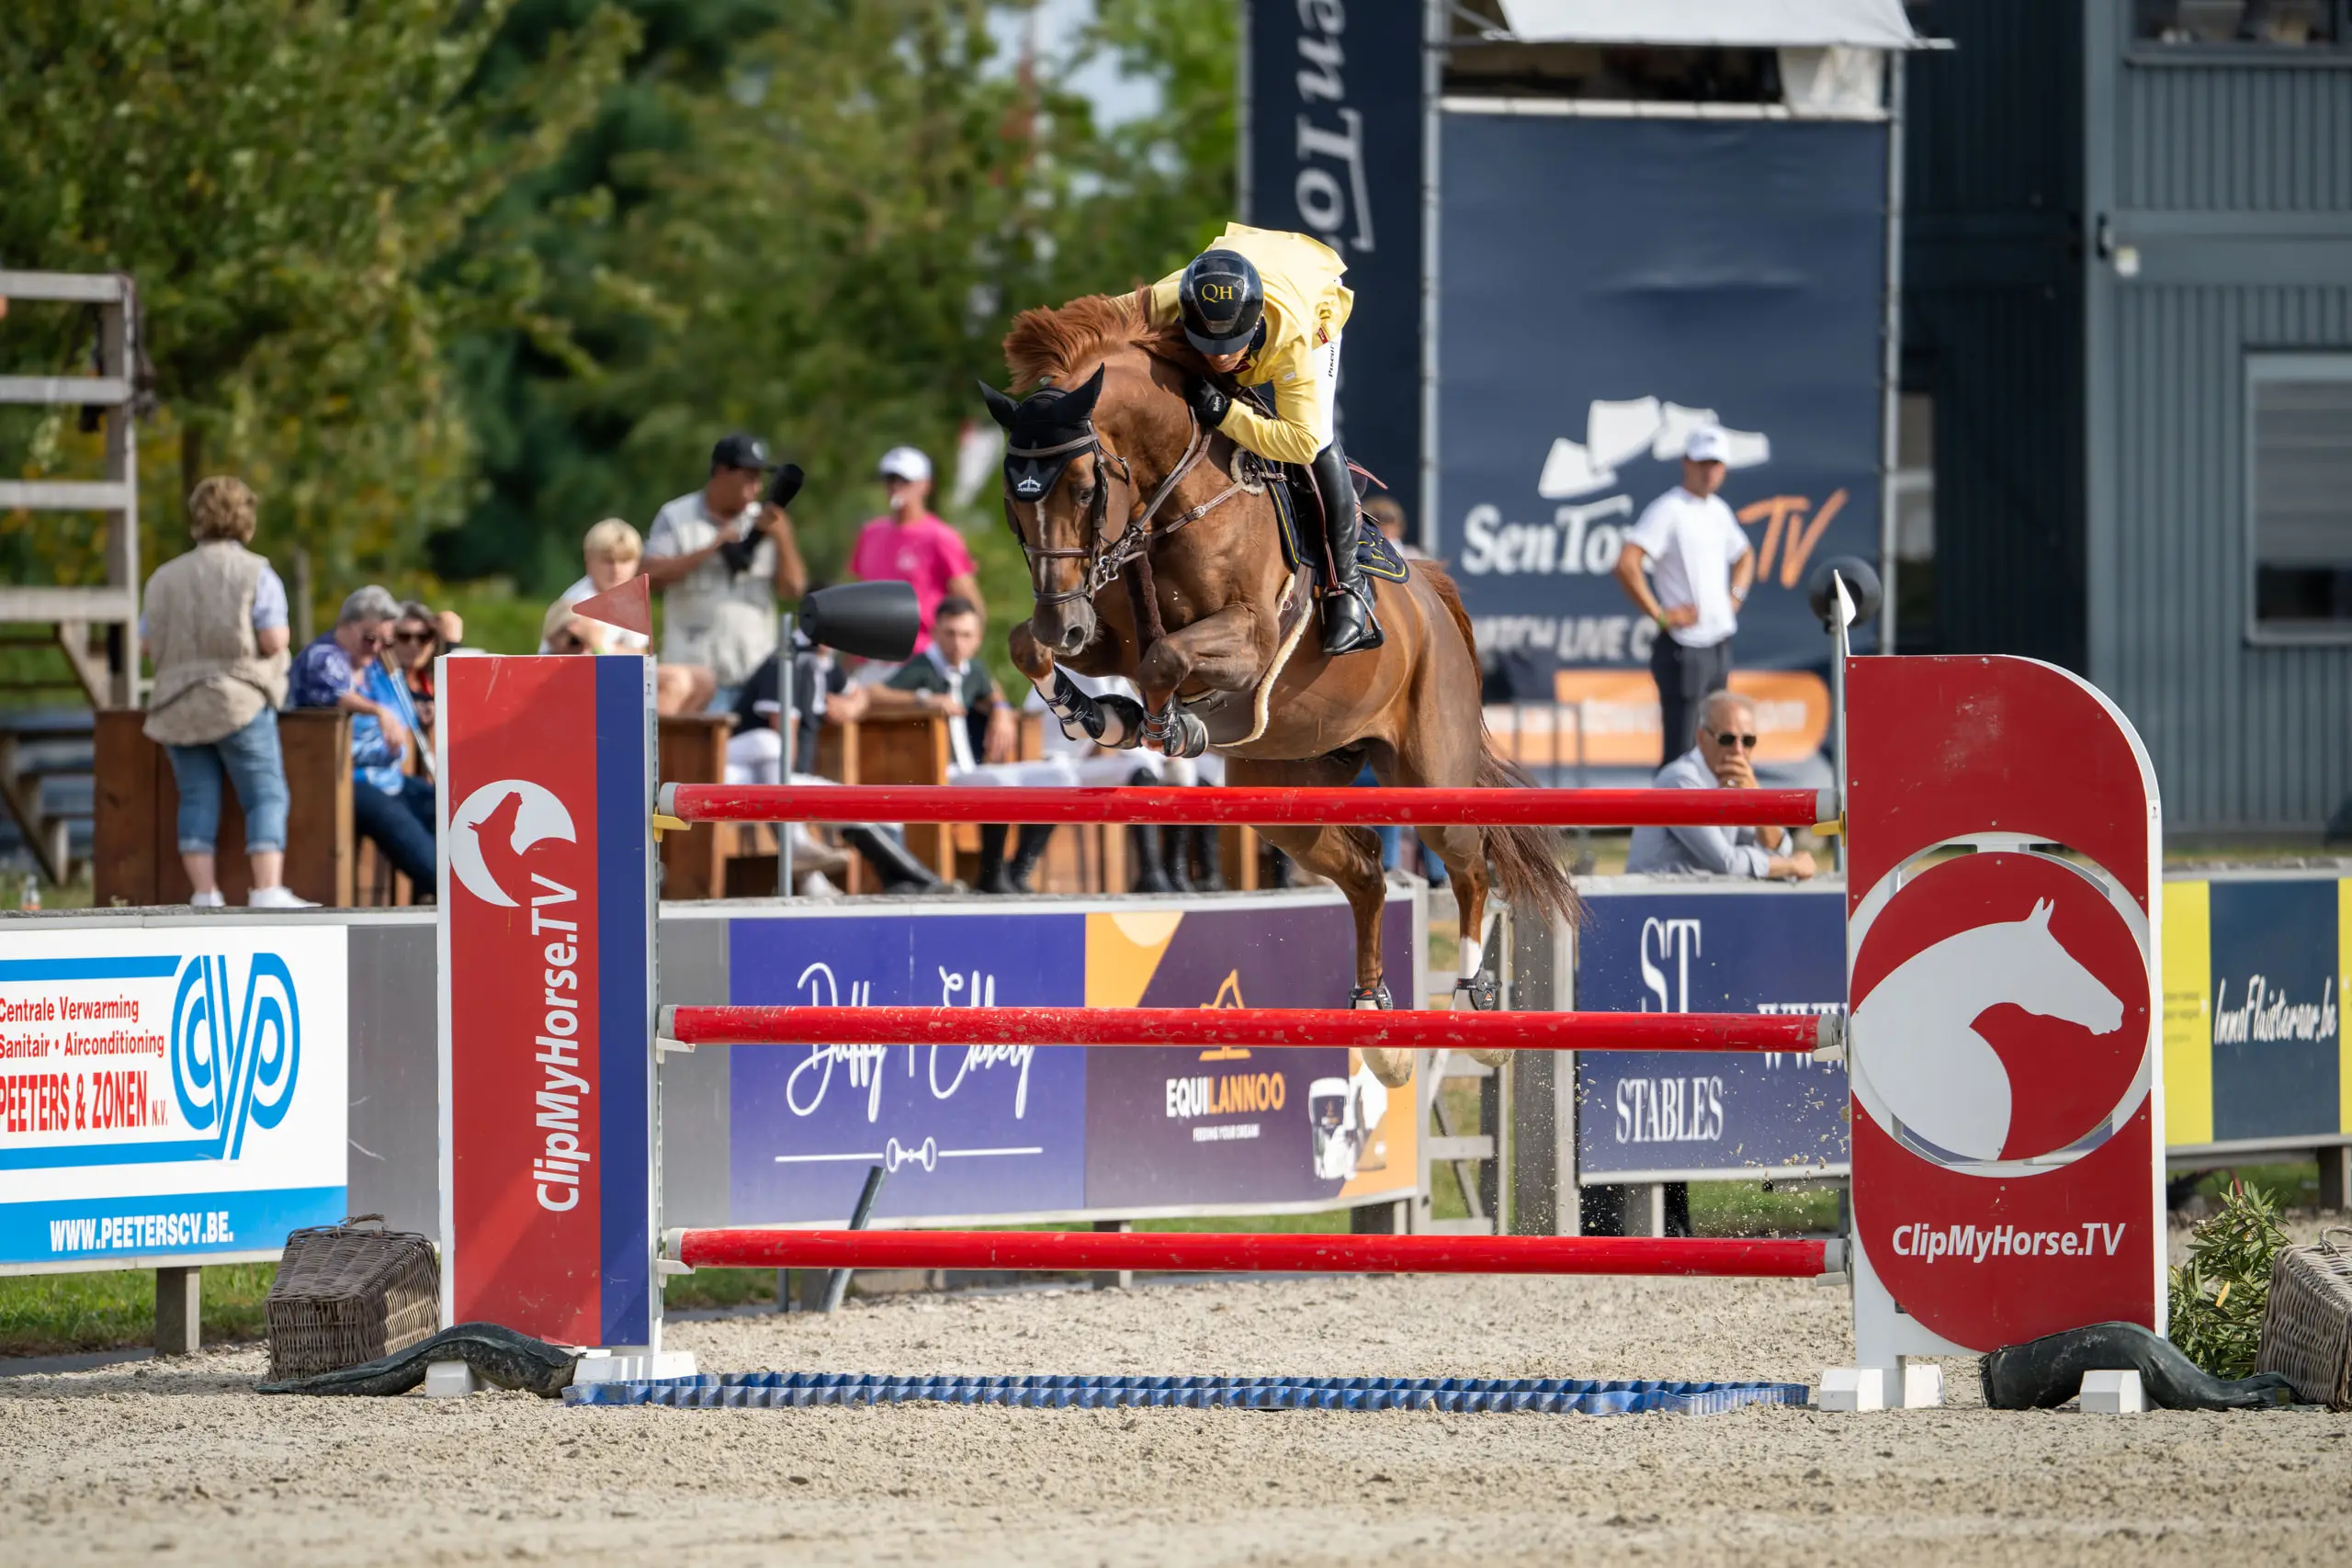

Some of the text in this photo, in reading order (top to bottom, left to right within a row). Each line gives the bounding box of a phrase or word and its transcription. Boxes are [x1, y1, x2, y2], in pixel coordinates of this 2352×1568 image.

[1201, 283, 1234, 303] QH
[1736, 488, 1849, 589] TV
[1641, 917, 1702, 1013] ST
[0, 994, 139, 1023] Centrale Verwarming
[0, 1029, 164, 1058] Sanitair Airconditioning
[531, 872, 591, 1212] ClipMyHorse.TV
[0, 1070, 168, 1133] PEETERS & ZONEN N.V.
[1166, 1072, 1286, 1118] EQUILANNOO
[1615, 1076, 1724, 1144] STABLES
[50, 1211, 234, 1252] WWW.PEETERSCV.BE.
[1892, 1223, 2126, 1263] ClipMyHorse.TV
